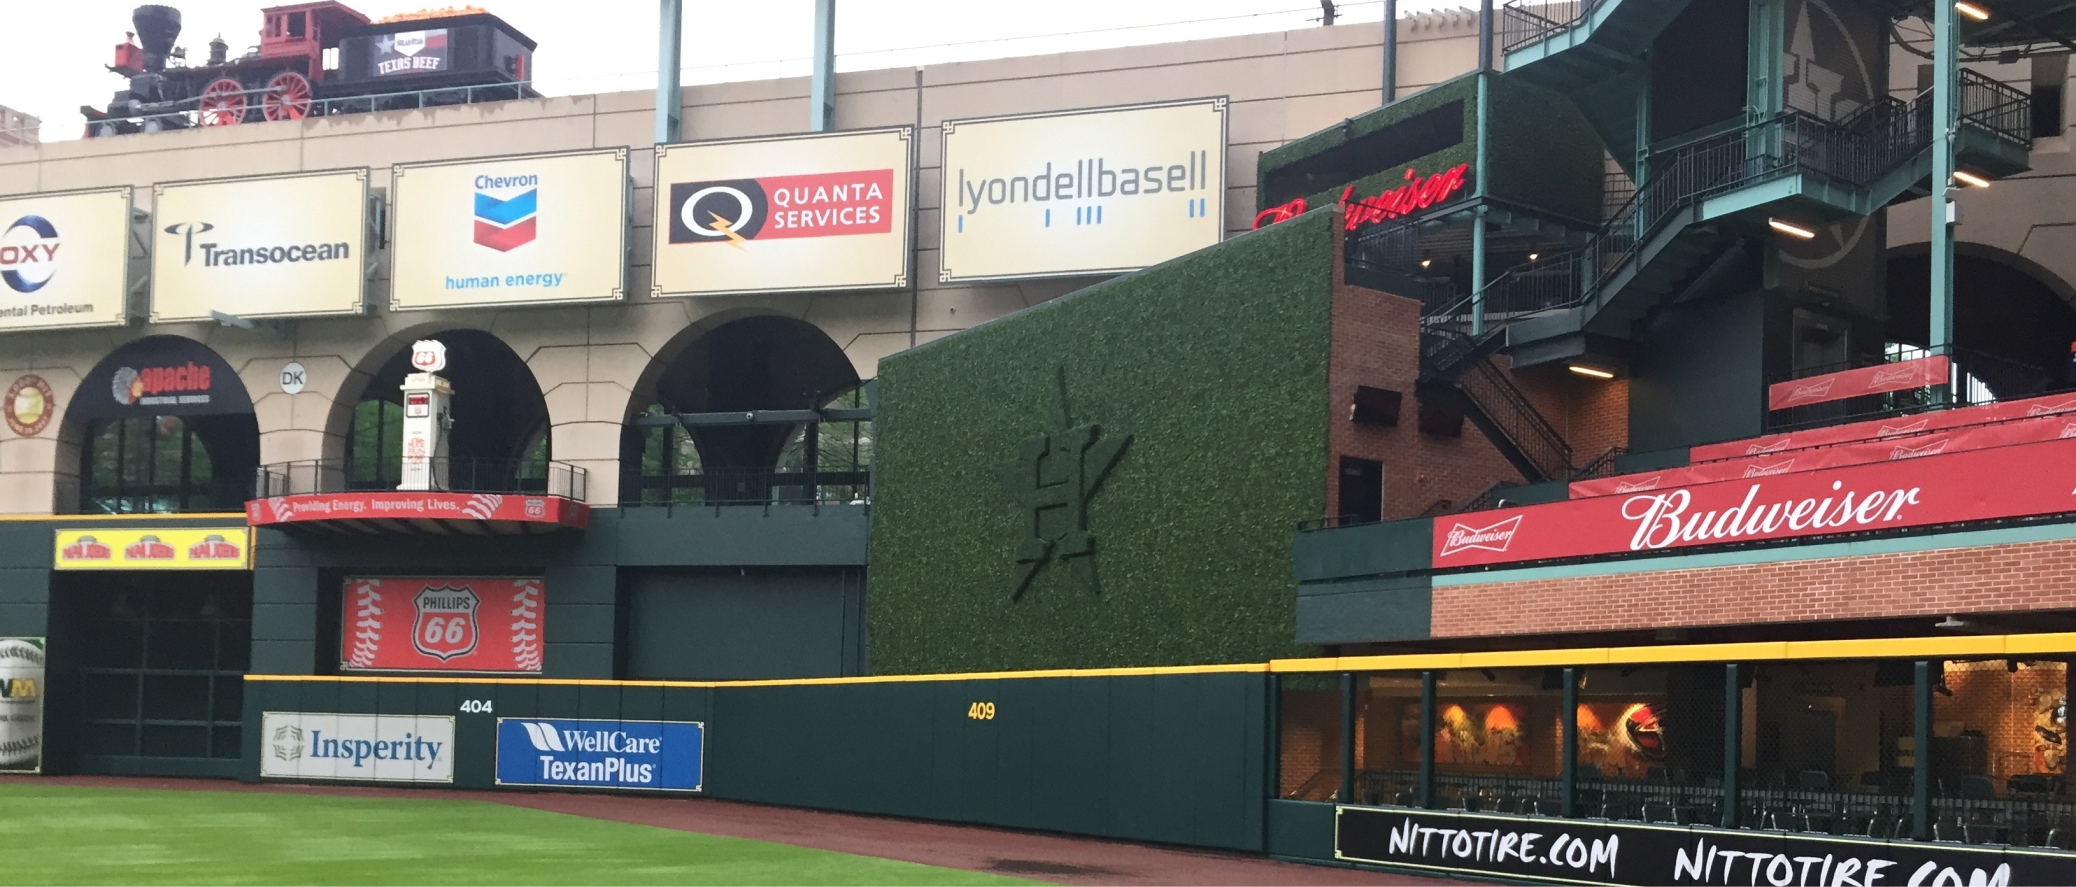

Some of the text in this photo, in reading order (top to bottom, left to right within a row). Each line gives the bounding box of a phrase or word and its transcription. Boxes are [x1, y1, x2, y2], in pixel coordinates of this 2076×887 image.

[378, 56, 441, 75] TEXAS BEEF
[474, 174, 538, 189] Chevron
[958, 149, 1206, 214] lyondellbasell
[773, 182, 883, 208] QUANTA
[774, 205, 881, 229] SERVICES
[0, 243, 60, 265] OXY
[200, 241, 349, 267] Transocean
[445, 272, 563, 290] human energy
[30, 302, 94, 316] Petroleum
[142, 361, 211, 395] apache
[282, 371, 304, 385] DK
[293, 498, 460, 513] Providing Energy. Improving Lives.
[527, 506, 542, 515] 66
[1621, 480, 1921, 551] Budweiser
[1447, 529, 1513, 547] Budweiser
[423, 596, 470, 610] PHILLIPS
[425, 617, 466, 644] 66
[460, 700, 493, 713] 404
[968, 701, 995, 720] 409
[310, 730, 443, 769] Insperity
[563, 730, 661, 754] WellCare
[540, 755, 653, 783] TexanPlus
[1389, 817, 1619, 878] NITTOTIRE.COM
